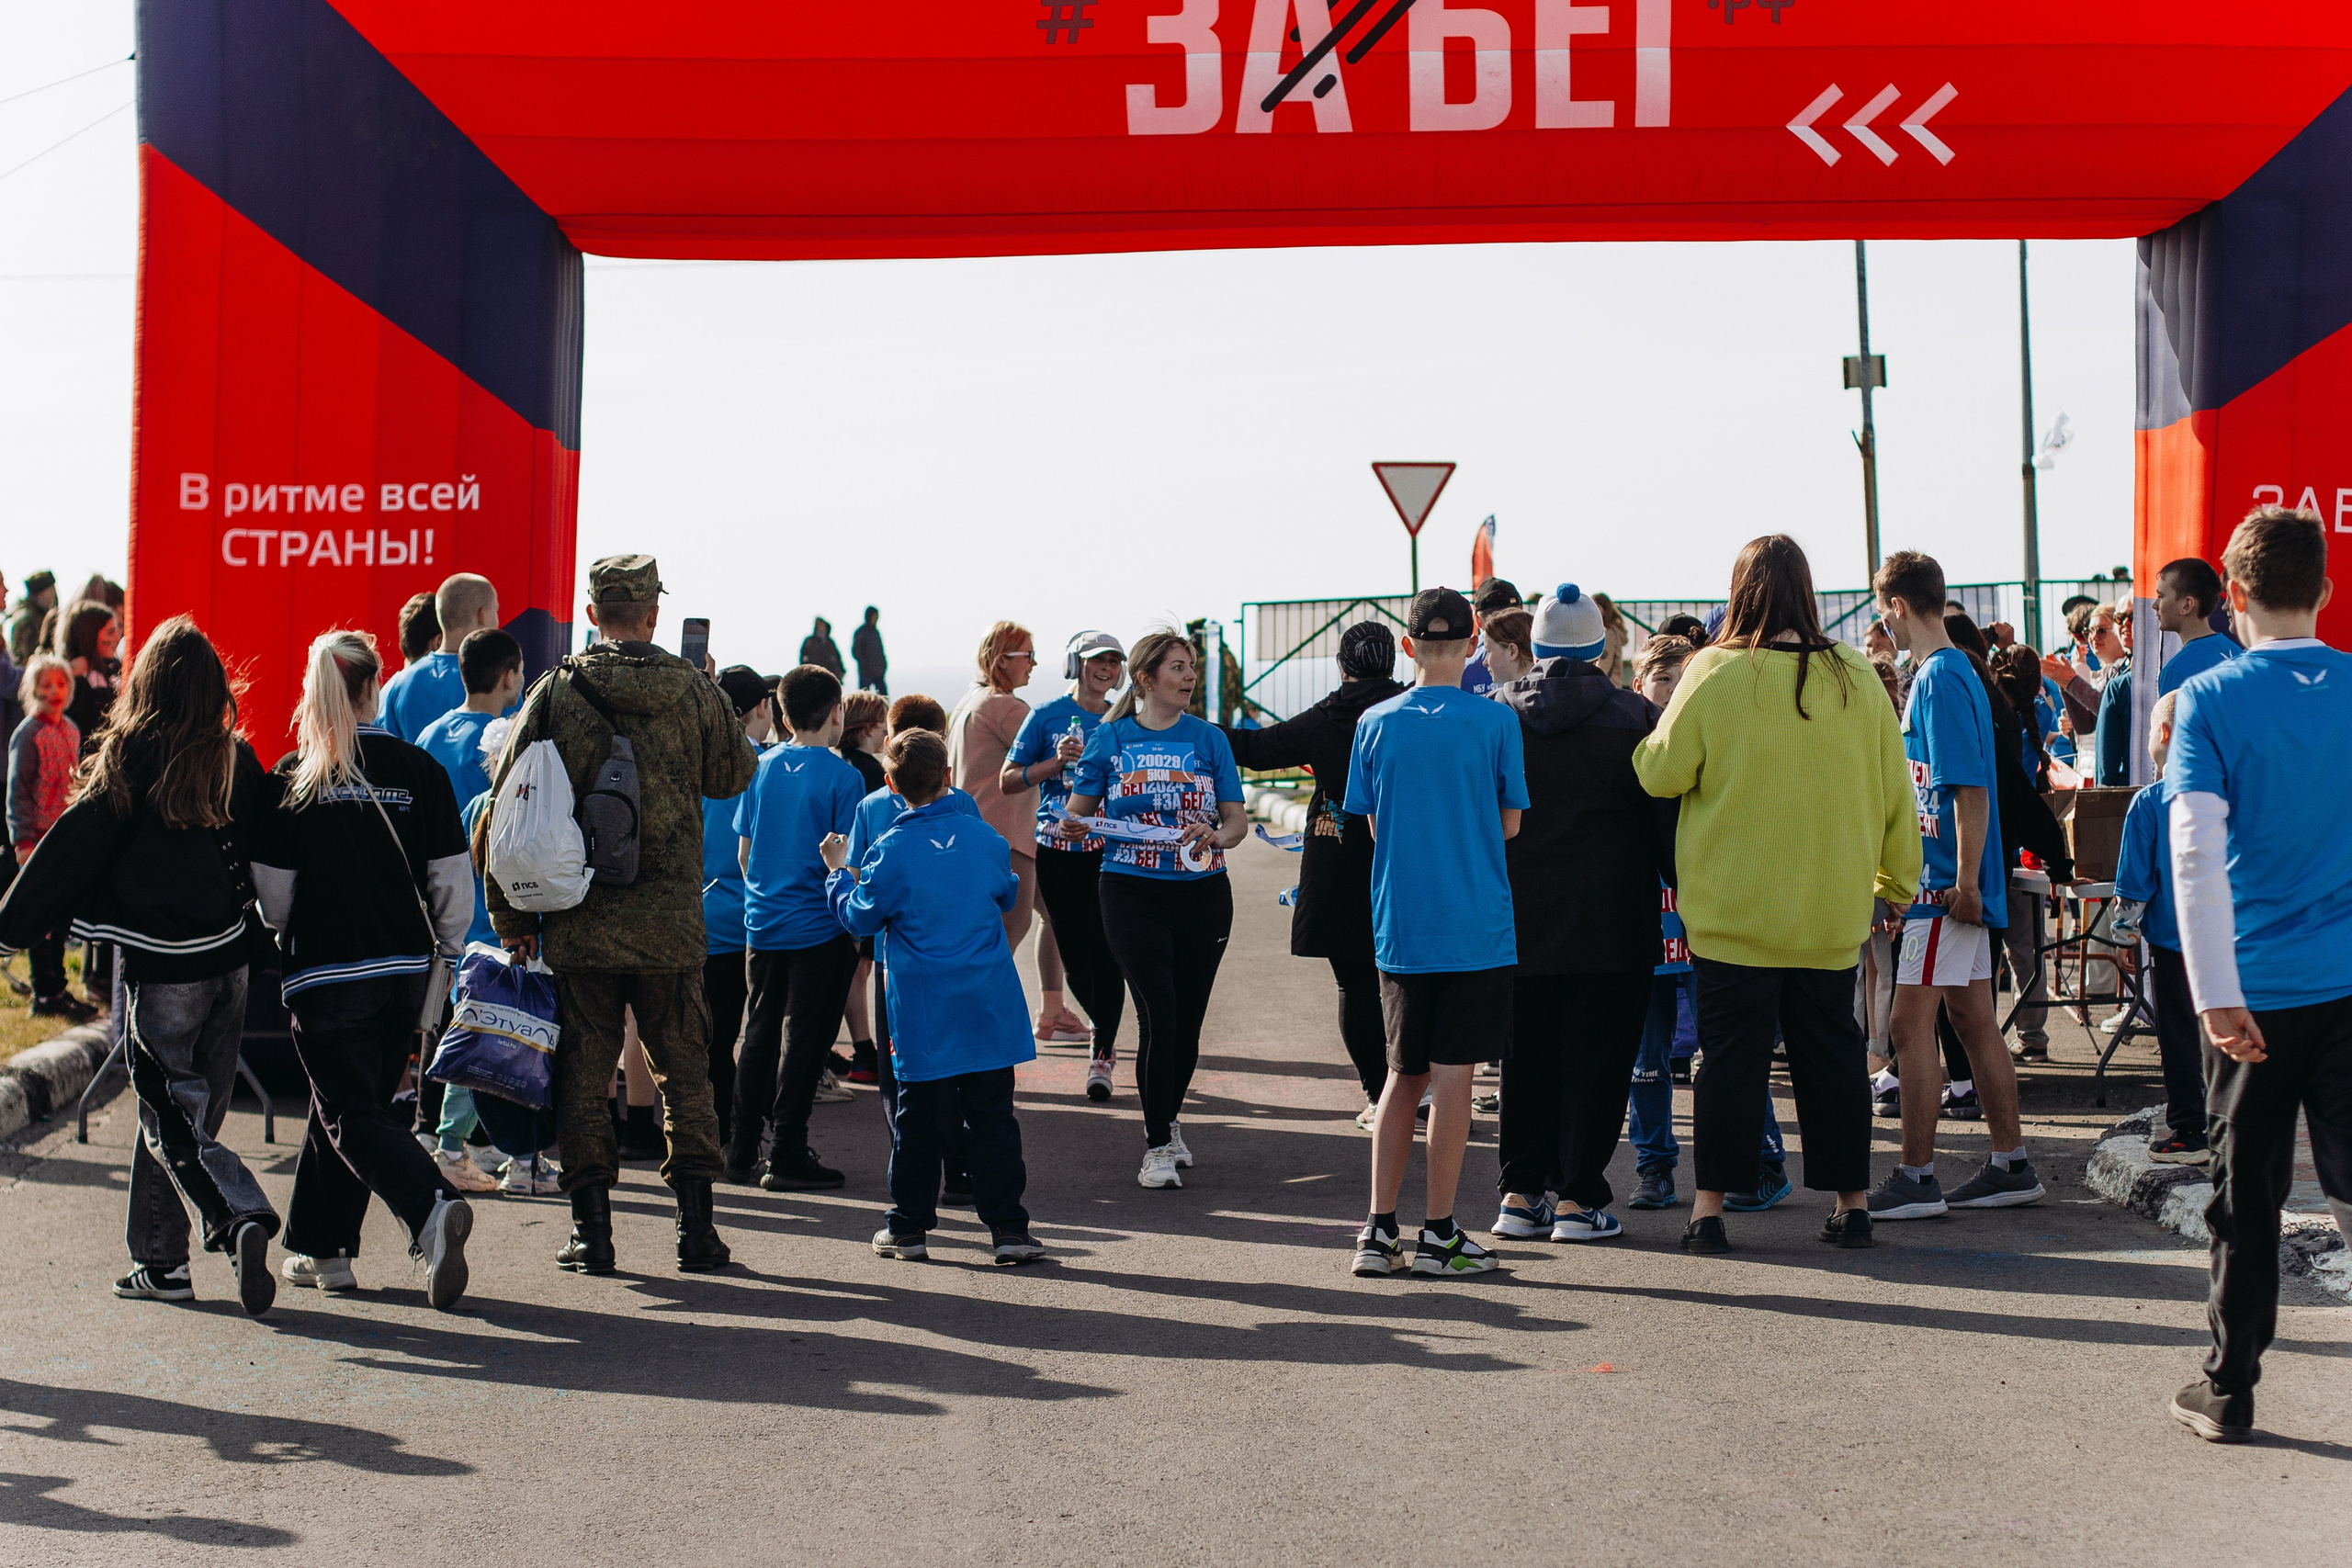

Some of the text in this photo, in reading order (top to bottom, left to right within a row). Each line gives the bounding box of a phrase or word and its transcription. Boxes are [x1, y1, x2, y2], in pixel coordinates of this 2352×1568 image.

[179, 472, 480, 518] В ритме всей
[221, 527, 435, 568] СТРАНЫ!
[1136, 753, 1181, 769] 20029
[521, 881, 539, 890] ПСБ
[497, 1038, 517, 1049] letu.ru
[1641, 1069, 1659, 1077] TIME
